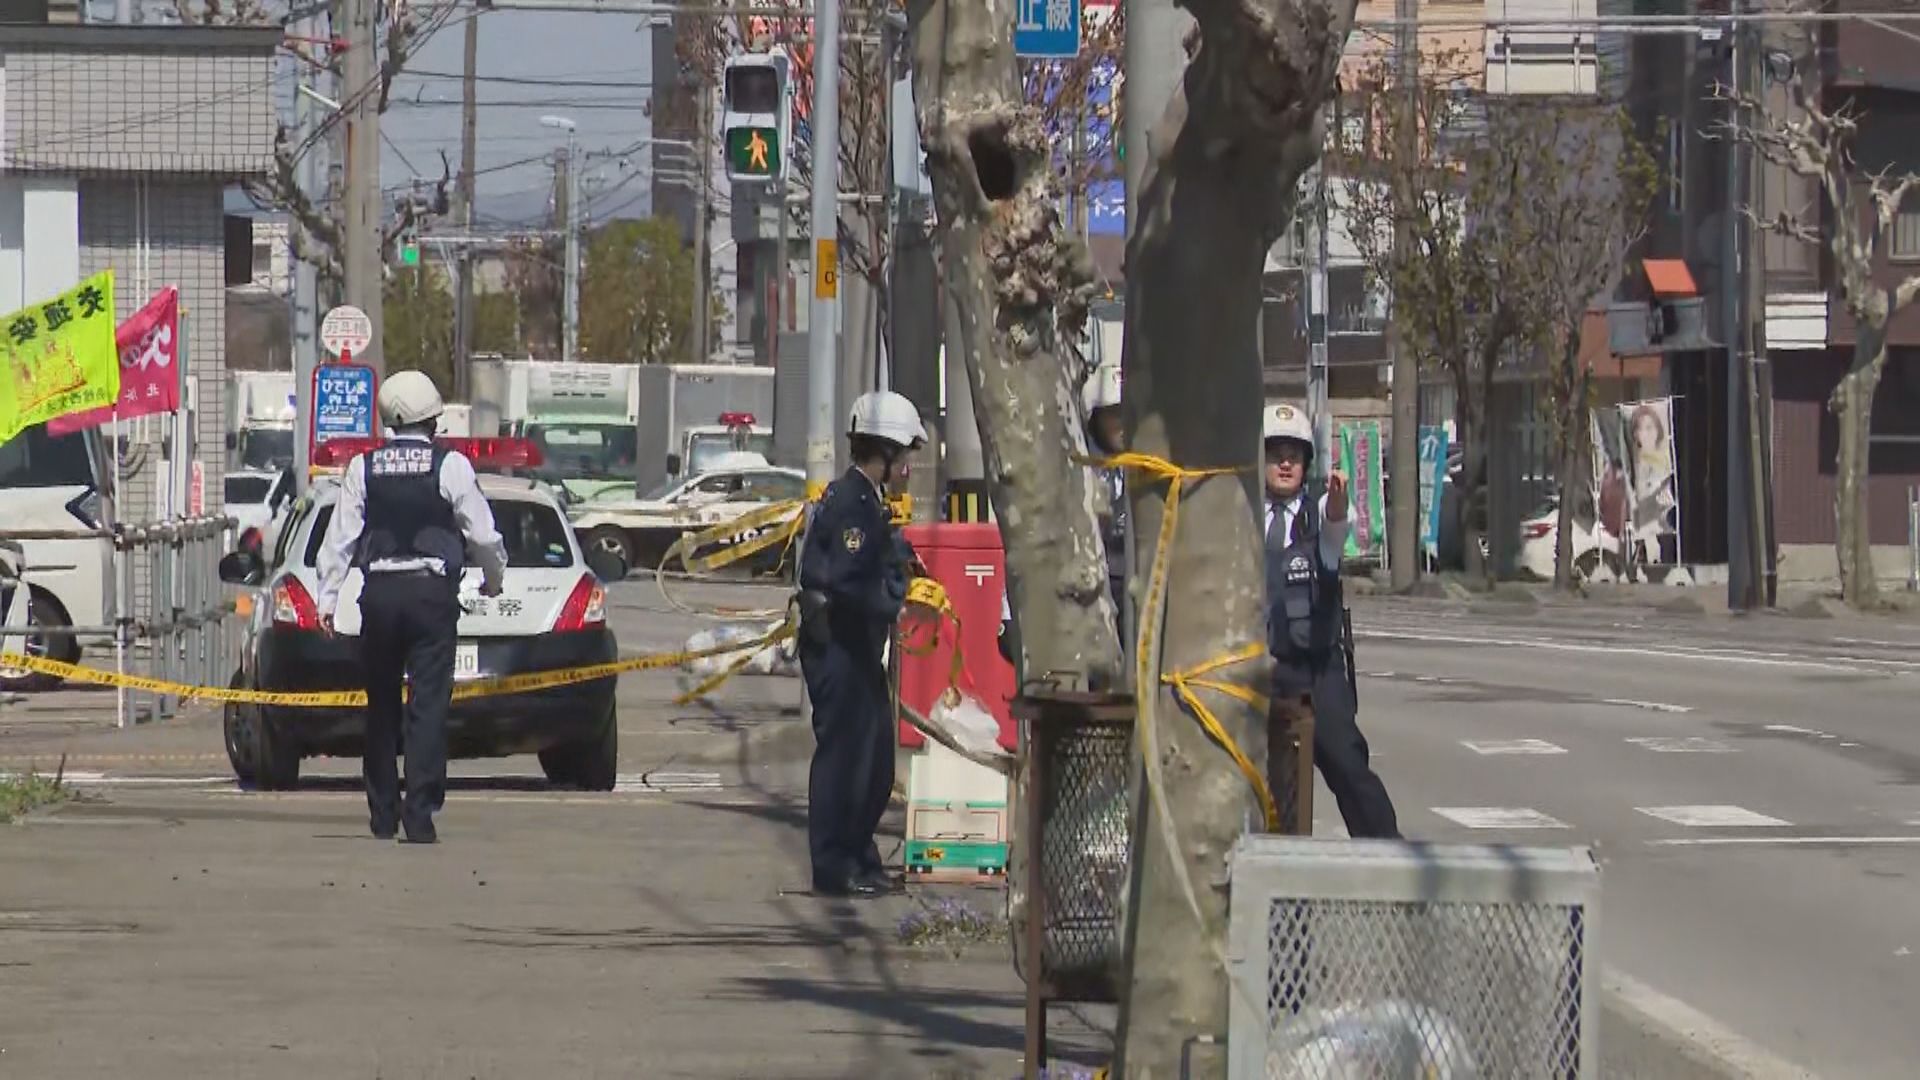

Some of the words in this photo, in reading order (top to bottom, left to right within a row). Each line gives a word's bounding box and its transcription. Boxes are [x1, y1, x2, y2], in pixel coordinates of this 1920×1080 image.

[322, 379, 368, 394] ひでしま
[328, 394, 359, 406] 内科
[319, 404, 367, 416] クリニック
[372, 448, 432, 463] POLICE
